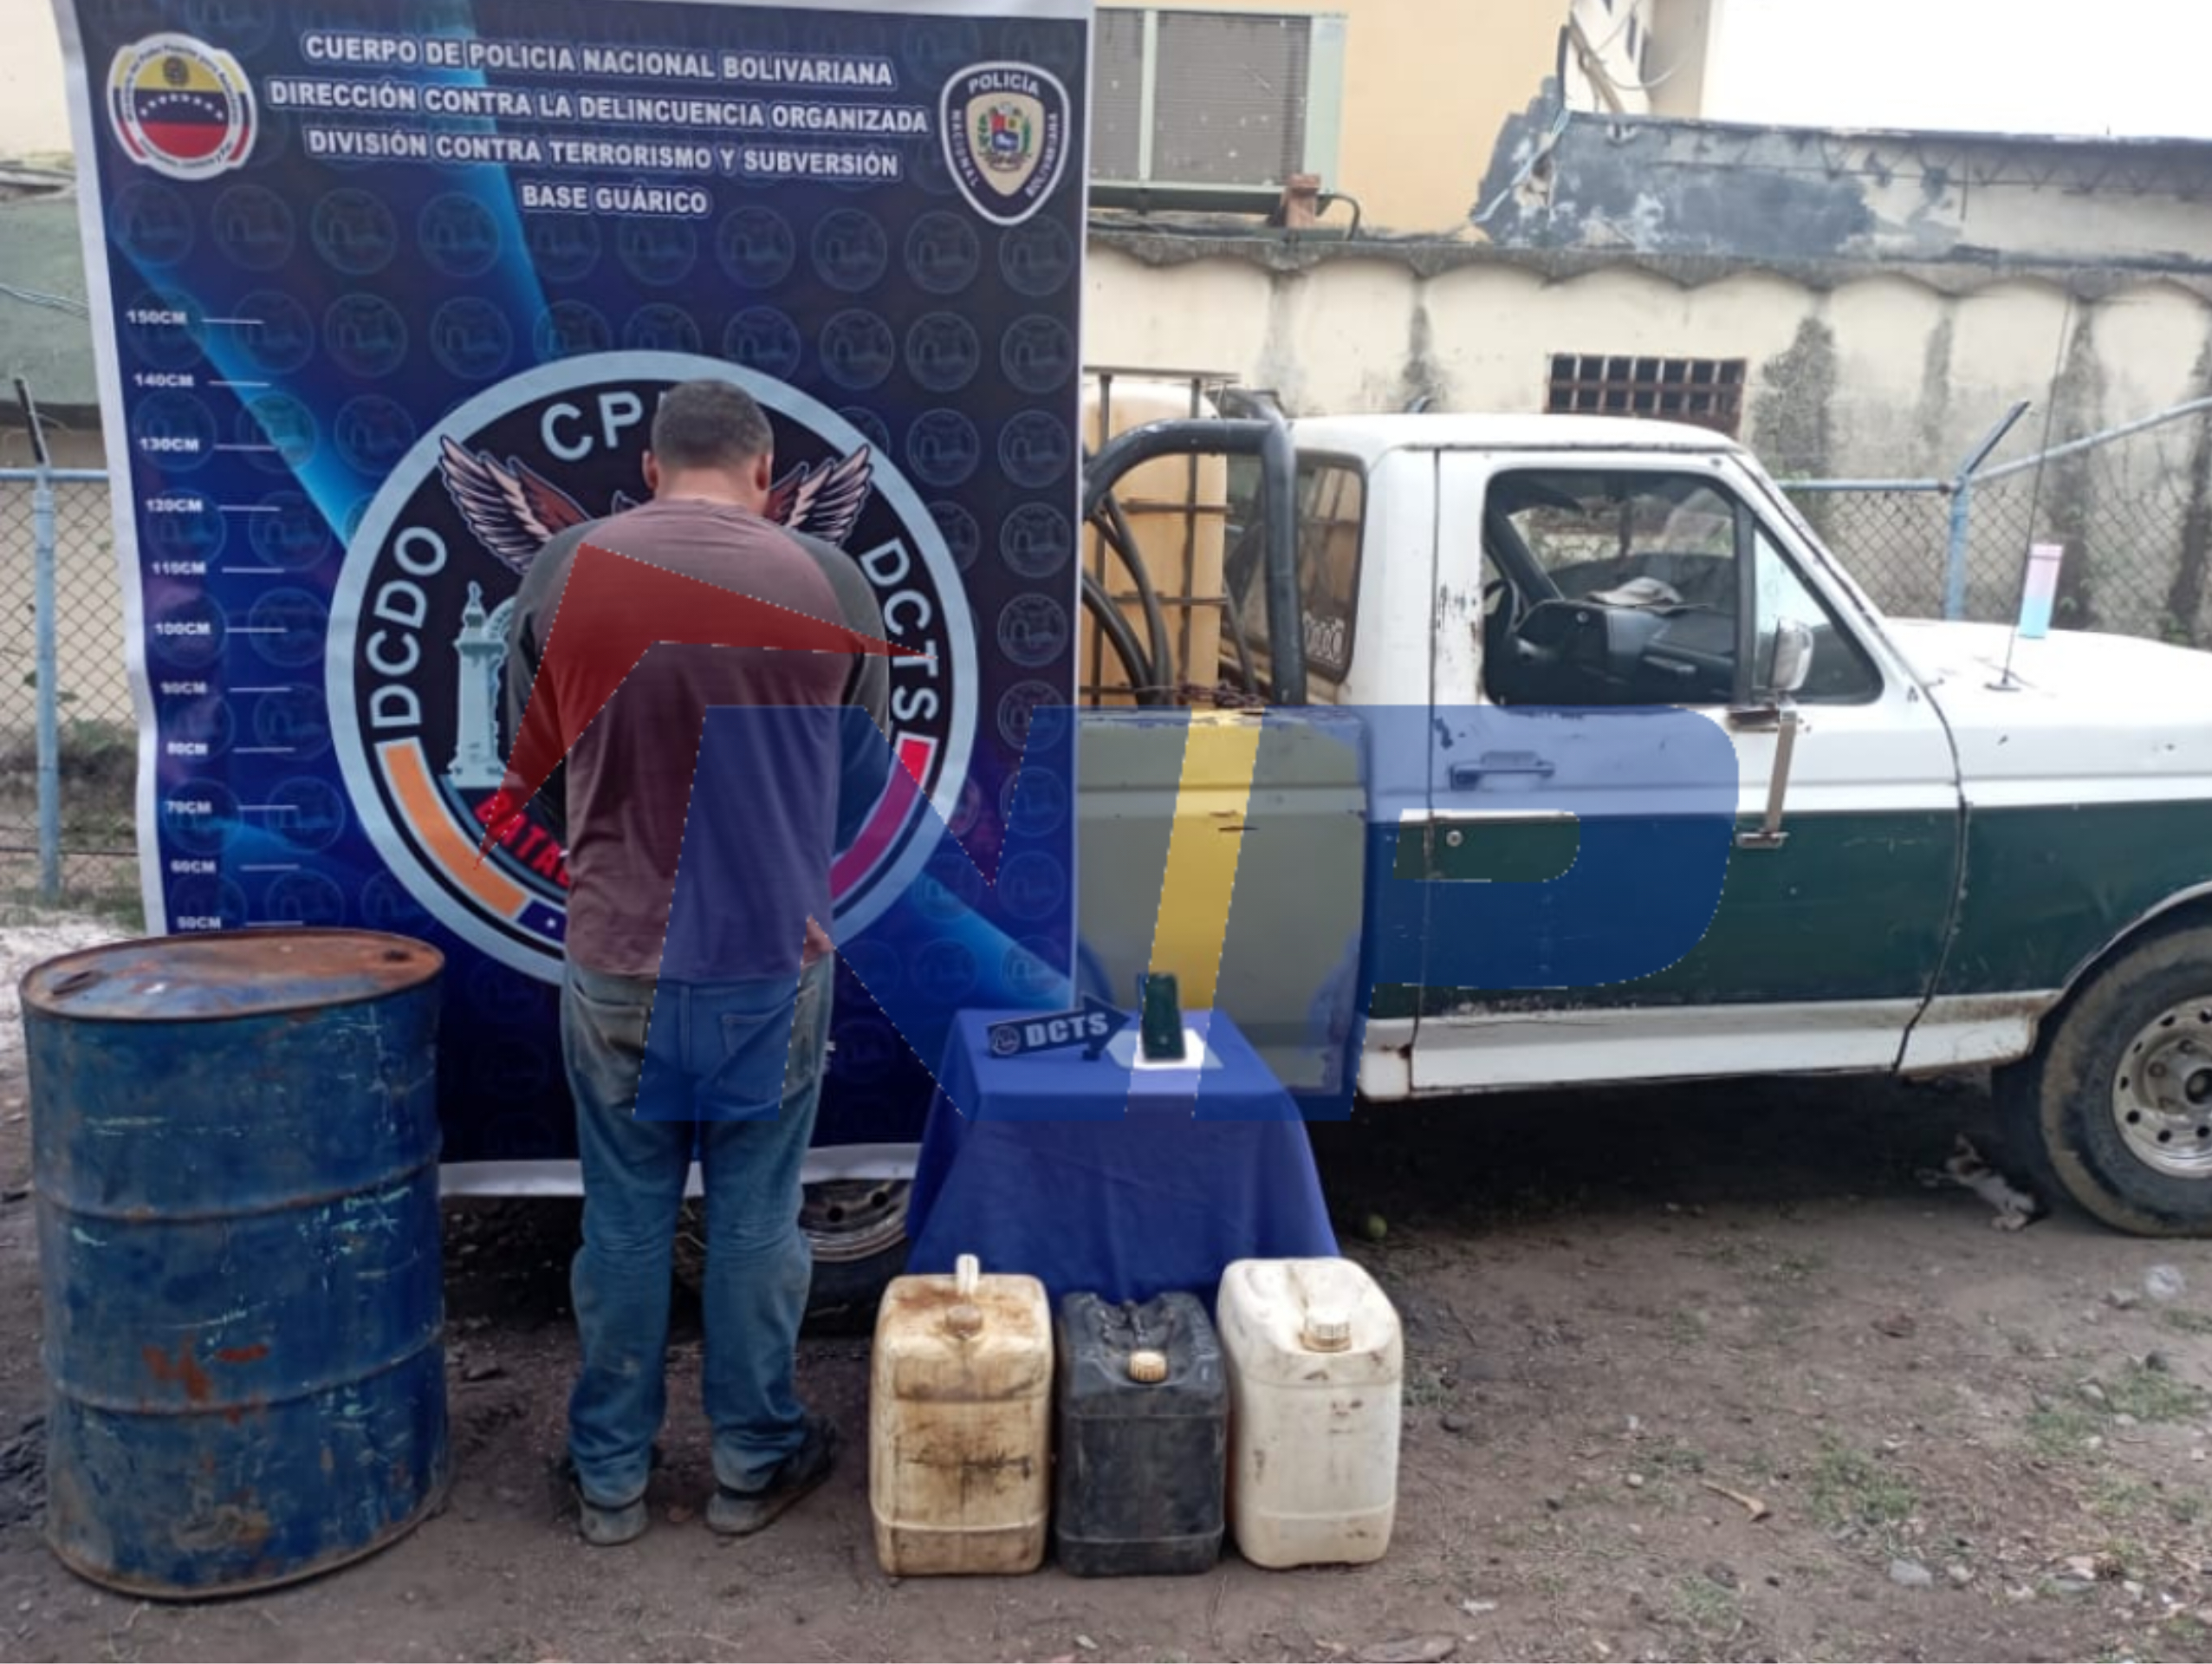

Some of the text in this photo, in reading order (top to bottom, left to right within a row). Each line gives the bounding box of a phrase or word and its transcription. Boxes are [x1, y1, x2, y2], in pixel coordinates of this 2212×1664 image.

[305, 36, 893, 86] CUERPO DE POLICIA NACIONAL BOLIVARIANA
[269, 81, 930, 133] DIRECCIÓN CONTRA LA DELINCUENCIA ORGANIZADA
[308, 129, 898, 176] DIVISIÓN CONTRA TERRORISMO Y SUBVERSIÓN
[951, 109, 979, 187] NACIONAL
[522, 185, 708, 213] BASE GUÁRICO
[126, 310, 188, 325] 150CM
[133, 374, 195, 387] 140CM
[541, 390, 665, 461] CP
[139, 438, 199, 452] 130CM
[146, 499, 203, 512] 120CM
[152, 562, 207, 575] 110CM
[156, 623, 211, 635] 100CM
[365, 526, 447, 730] DCDO
[860, 537, 939, 721] DCTS
[165, 801, 212, 814] 70CM
[1024, 1011, 1108, 1047] DCTS
